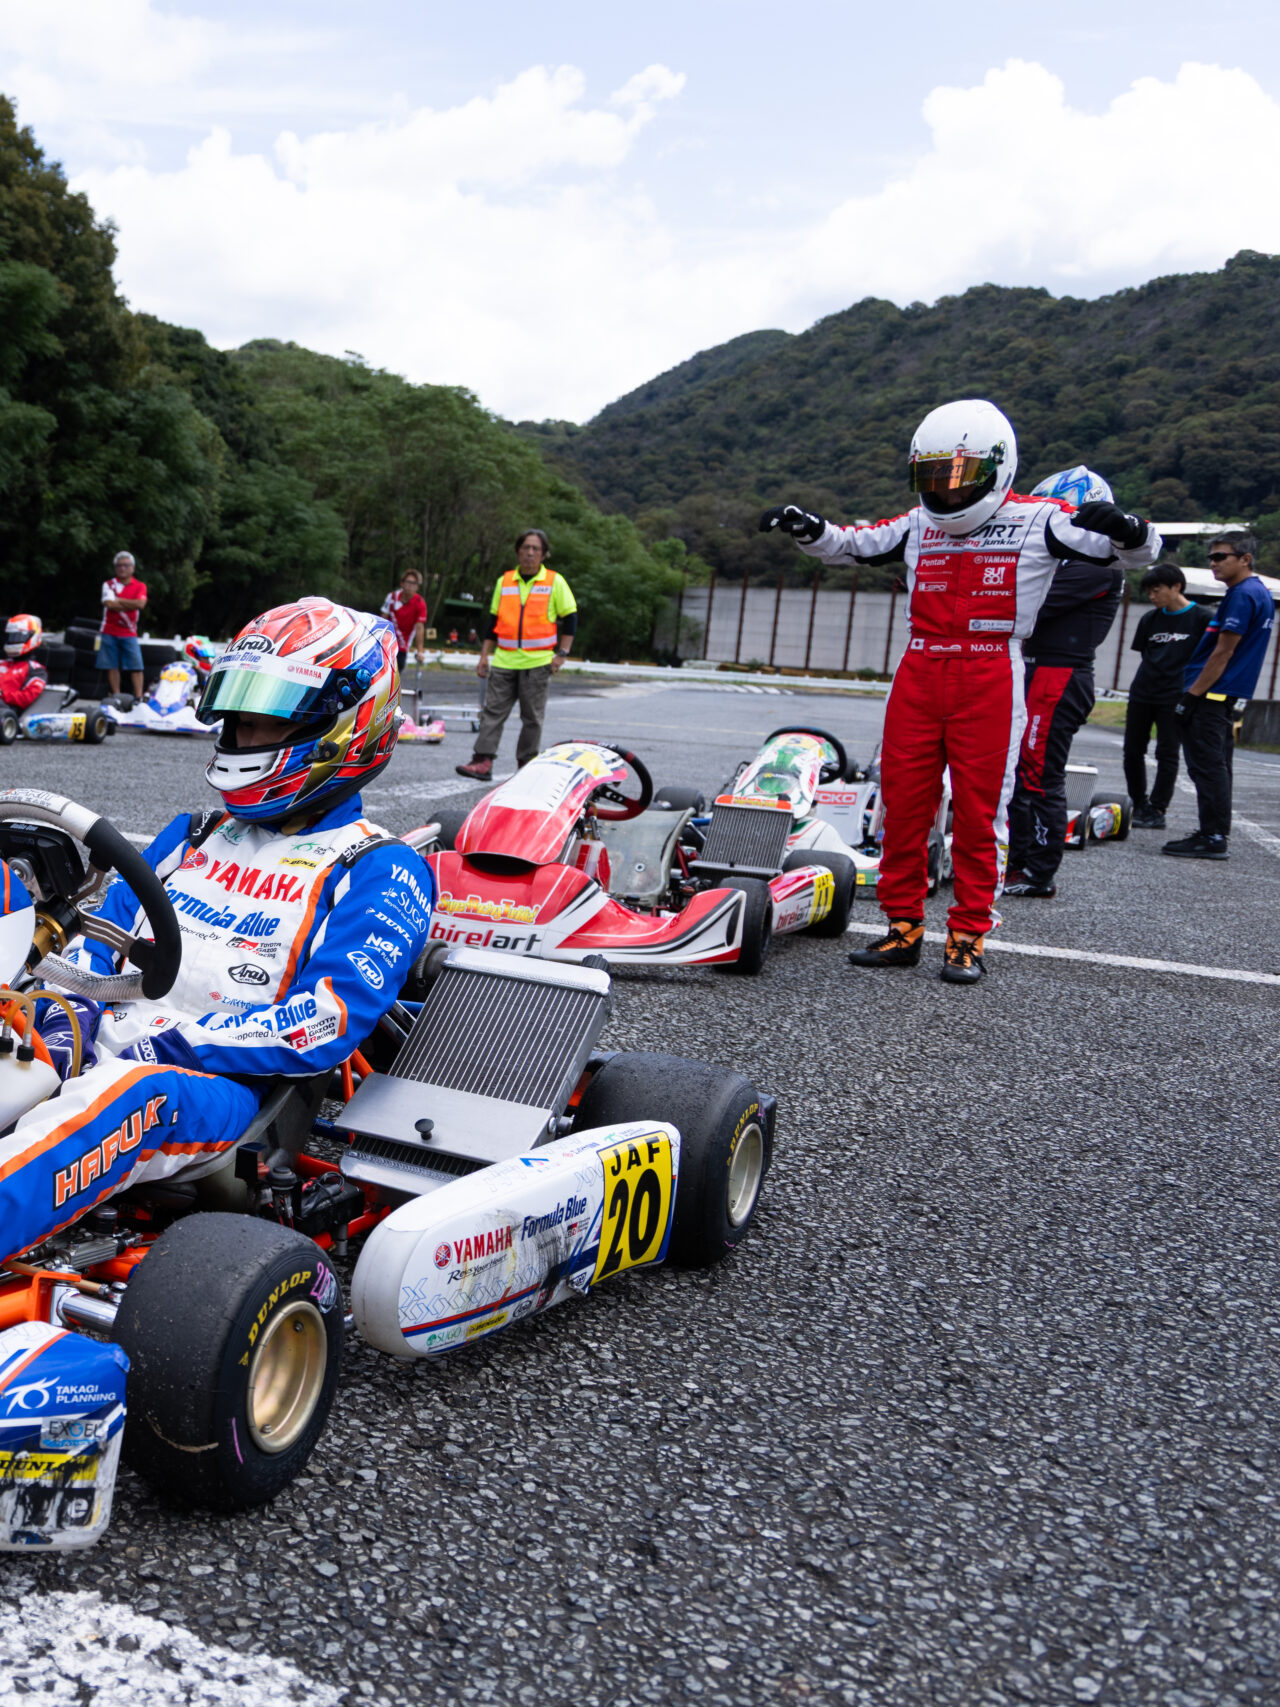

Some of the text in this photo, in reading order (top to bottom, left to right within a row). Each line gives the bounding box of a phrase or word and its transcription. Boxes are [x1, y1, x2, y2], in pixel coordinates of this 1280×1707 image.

[921, 541, 946, 549] super
[981, 538, 1020, 548] junkie!
[983, 555, 1016, 564] YAMAHA
[230, 635, 266, 652] Arai
[241, 651, 260, 663] Blue
[970, 643, 1003, 652] NAO.K
[295, 667, 322, 680] YAMAHA
[391, 864, 432, 918] YAMAHA
[167, 882, 281, 937] ormula Blue
[398, 891, 427, 934] SUGO
[209, 931, 222, 941] by
[365, 932, 403, 963] NGK
[430, 921, 542, 952] birelart
[351, 954, 384, 987] Arai
[275, 998, 318, 1032] Blue
[306, 1016, 336, 1031] TOYOTA
[309, 1022, 335, 1037] GAZOO
[310, 1028, 336, 1044] Racing
[730, 1103, 759, 1151] DUNLOP
[53, 1094, 178, 1210] HARUK
[611, 1136, 661, 1176] JAF
[521, 1202, 565, 1242] Formula
[564, 1195, 588, 1222] Blue
[596, 1168, 662, 1281] 20
[453, 1225, 513, 1265] YAMAHA
[248, 1270, 312, 1347] DUNLOP
[437, 1327, 462, 1345] SUGO
[56, 1385, 99, 1395] TAKAGI
[56, 1392, 117, 1404] PLANNING
